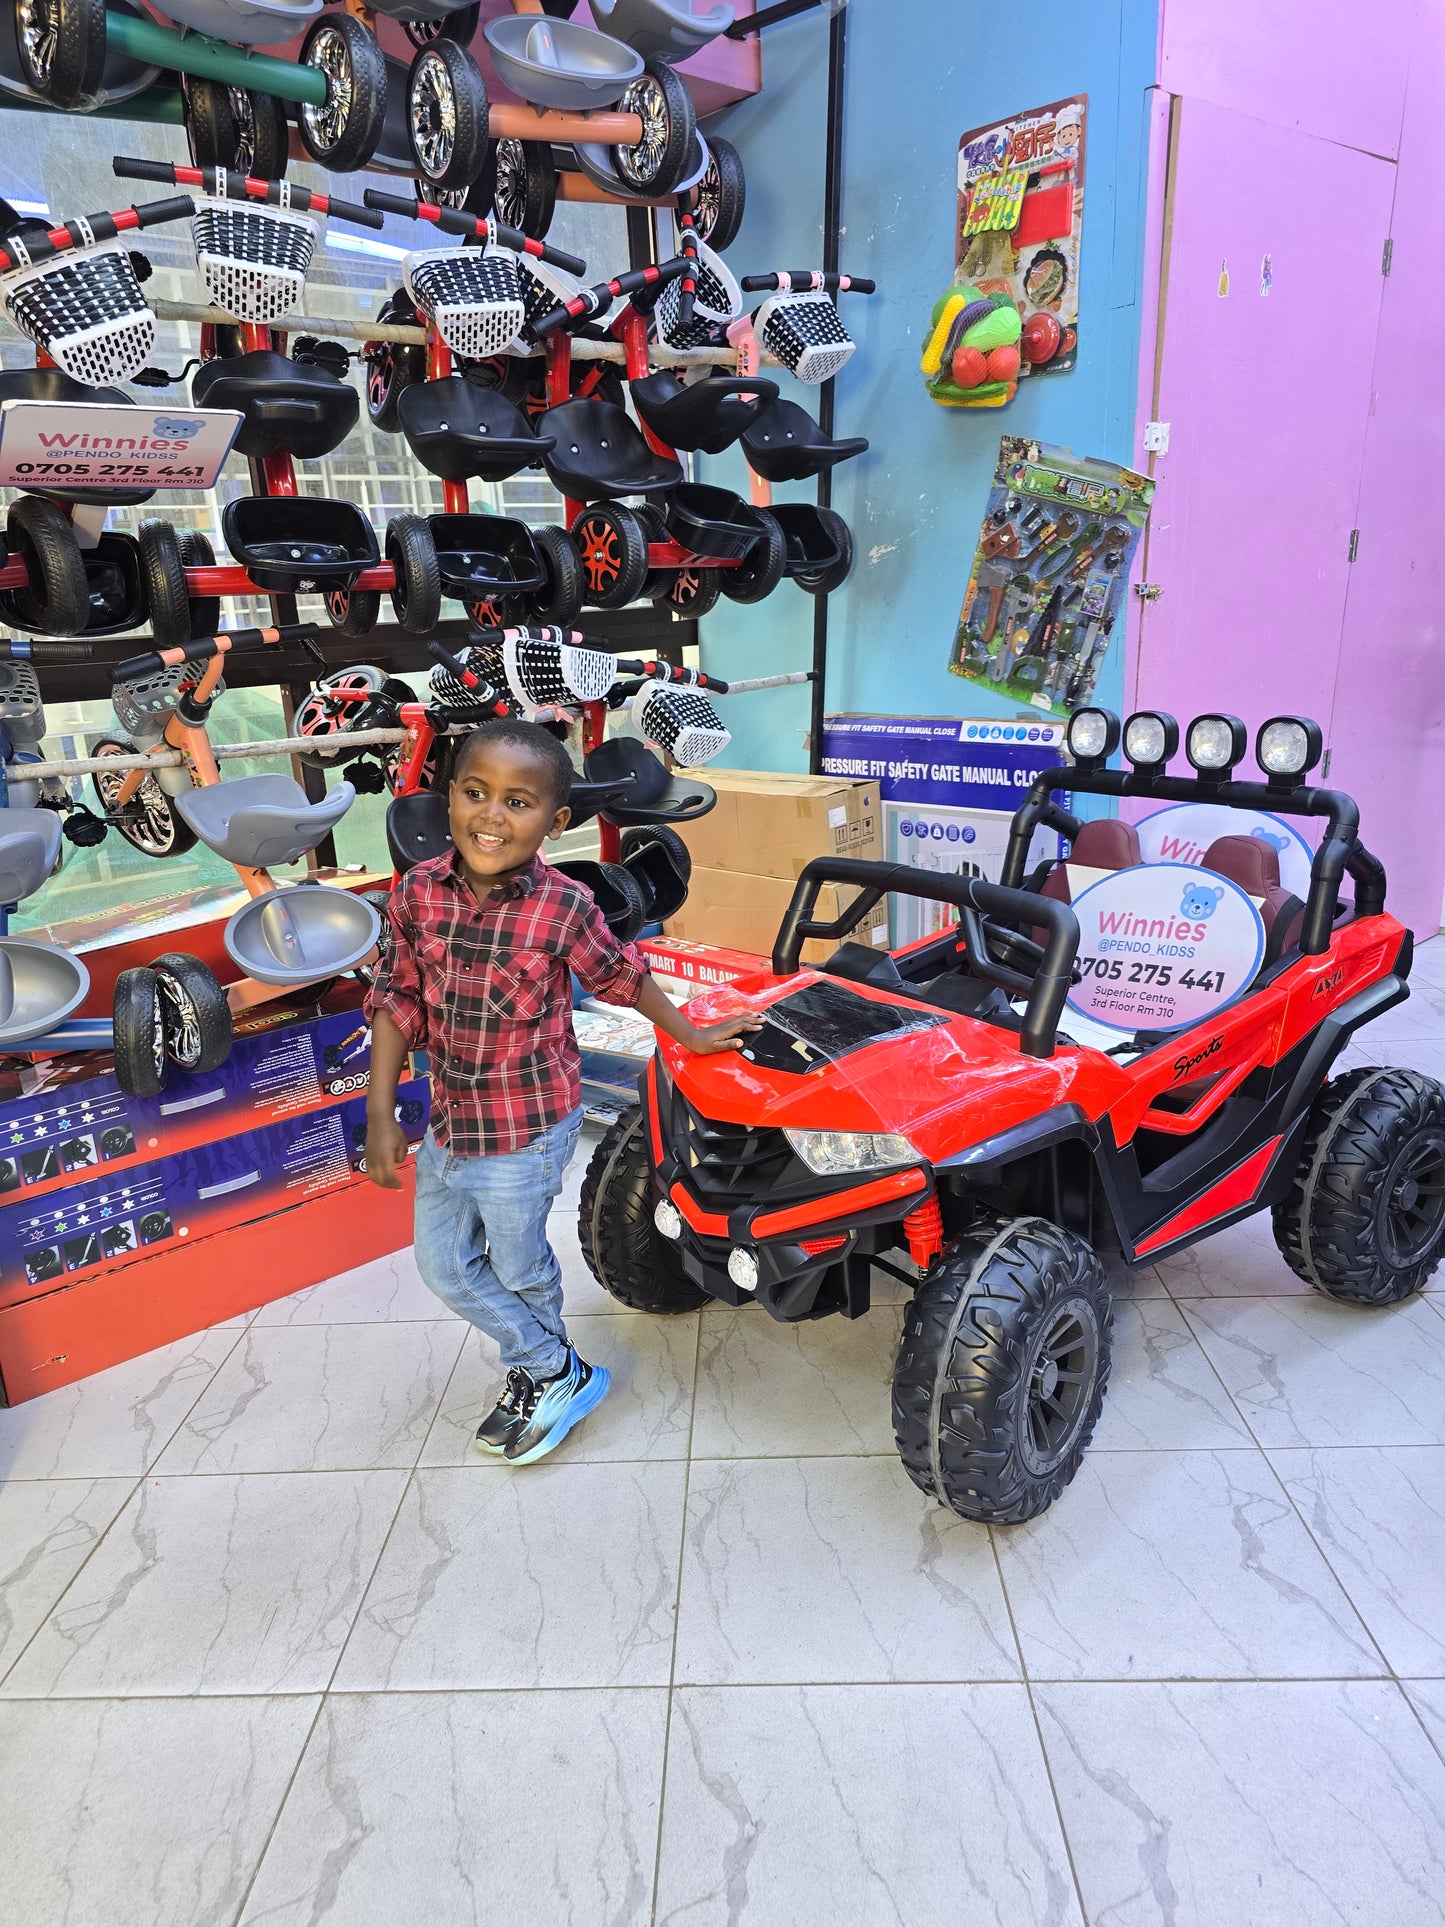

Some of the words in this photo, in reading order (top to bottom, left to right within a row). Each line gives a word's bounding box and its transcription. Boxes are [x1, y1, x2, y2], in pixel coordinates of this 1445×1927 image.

[38, 433, 190, 451] Winnies
[46, 450, 178, 460] @PENDO_KIDSS
[8, 476, 62, 484] Superior
[15, 463, 90, 475] 0705
[98, 464, 149, 476] 275
[157, 466, 204, 477] 441
[851, 724, 861, 732] FIT
[861, 725, 886, 733] SAFETY
[886, 726, 904, 734] GATE
[905, 727, 932, 735] MANUAL
[933, 728, 956, 736] CLOSE
[870, 760, 886, 777] FIT
[888, 761, 928, 780] SAFETY
[930, 764, 961, 782] GATE
[962, 766, 1011, 787] MANUAL
[1098, 911, 1208, 942] Winnies
[1097, 938, 1196, 958] @PENDO_KIDSS
[681, 961, 694, 978] 10
[1128, 962, 1173, 987] 275
[1178, 968, 1226, 993] 441
[1310, 963, 1344, 1002] 4x4
[1094, 985, 1137, 1001] Superior
[1139, 990, 1177, 1006] Centre,
[1090, 998, 1107, 1008] 3rd
[1109, 1000, 1135, 1013] Floor
[1137, 1004, 1154, 1015] Rm
[1156, 1007, 1174, 1018] J10
[1173, 1034, 1225, 1082] Sports
[28, 1275, 37, 1283] 4
